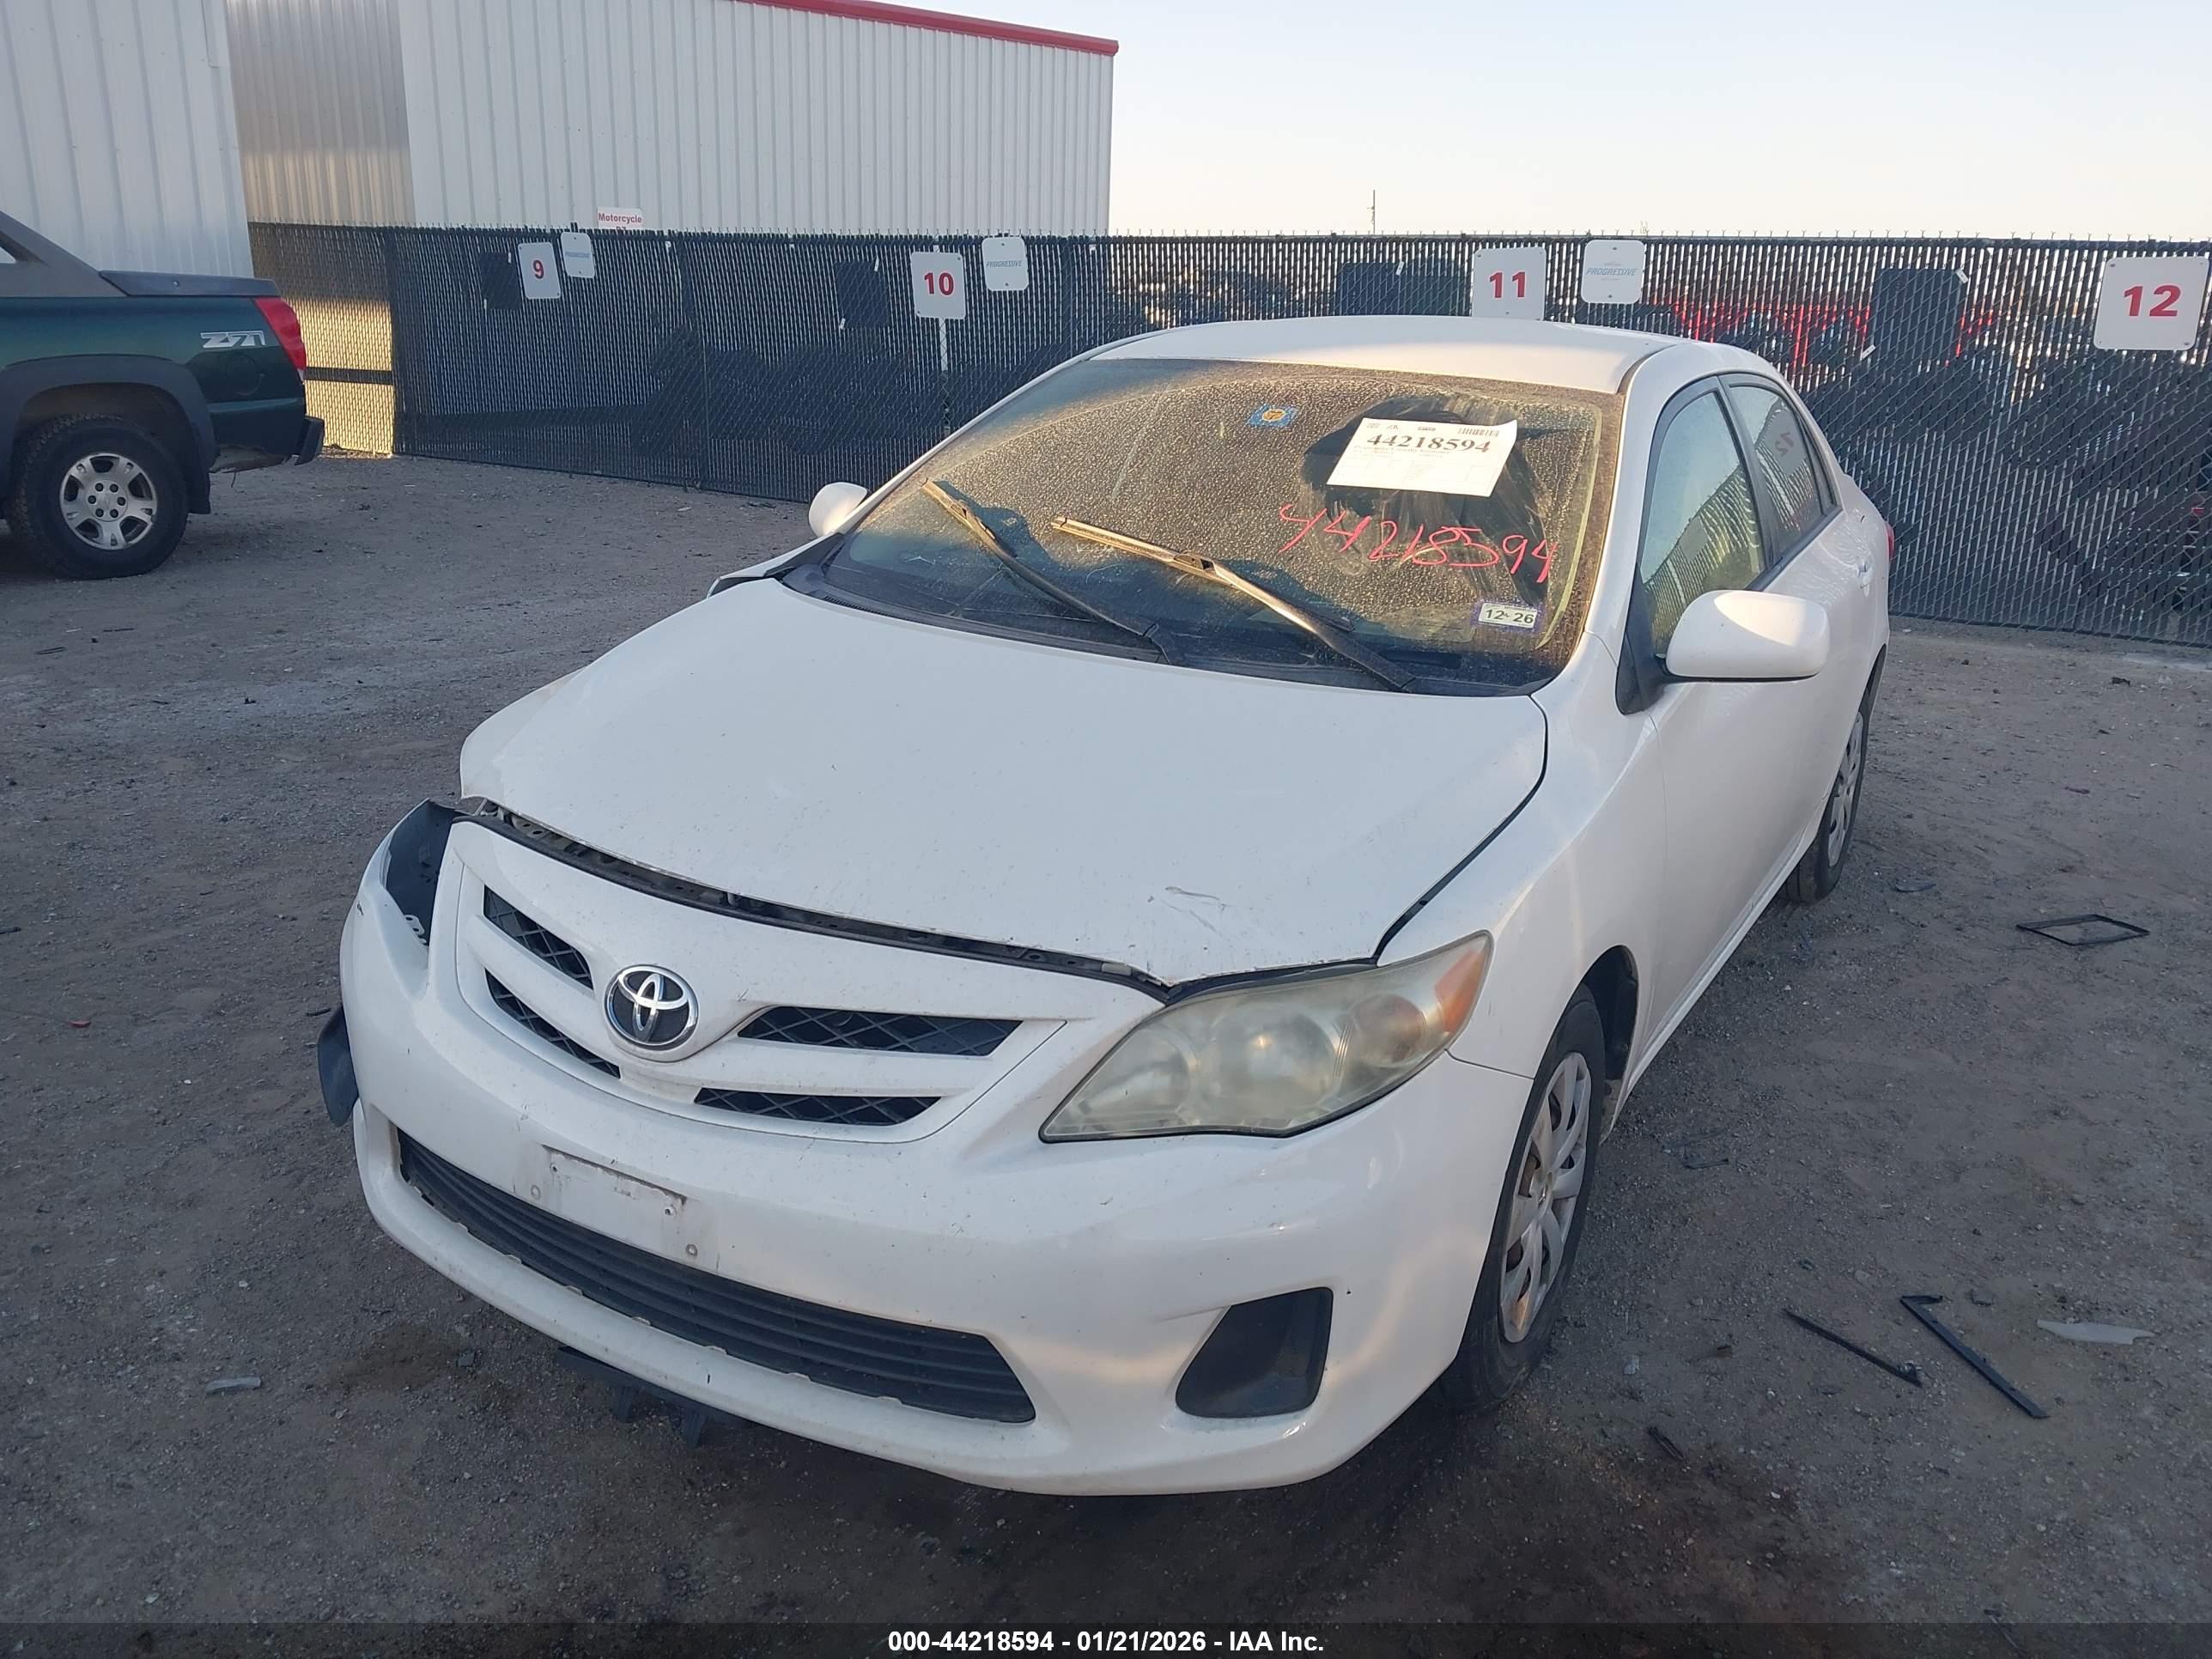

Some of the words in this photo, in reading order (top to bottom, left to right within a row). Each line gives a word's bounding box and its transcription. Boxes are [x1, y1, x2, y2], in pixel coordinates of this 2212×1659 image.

[599, 212, 642, 224] Motorcycle
[532, 259, 544, 279] 9
[1586, 267, 1638, 276] PROGRESSIVE
[924, 272, 954, 295] 10
[1489, 271, 1526, 298] 11
[2124, 284, 2182, 317] 12
[200, 330, 266, 349] Z71
[1367, 434, 1491, 453] 44218594
[1278, 503, 1559, 583] 44218594
[1485, 609, 1504, 620] 12
[1513, 612, 1534, 623] 26
